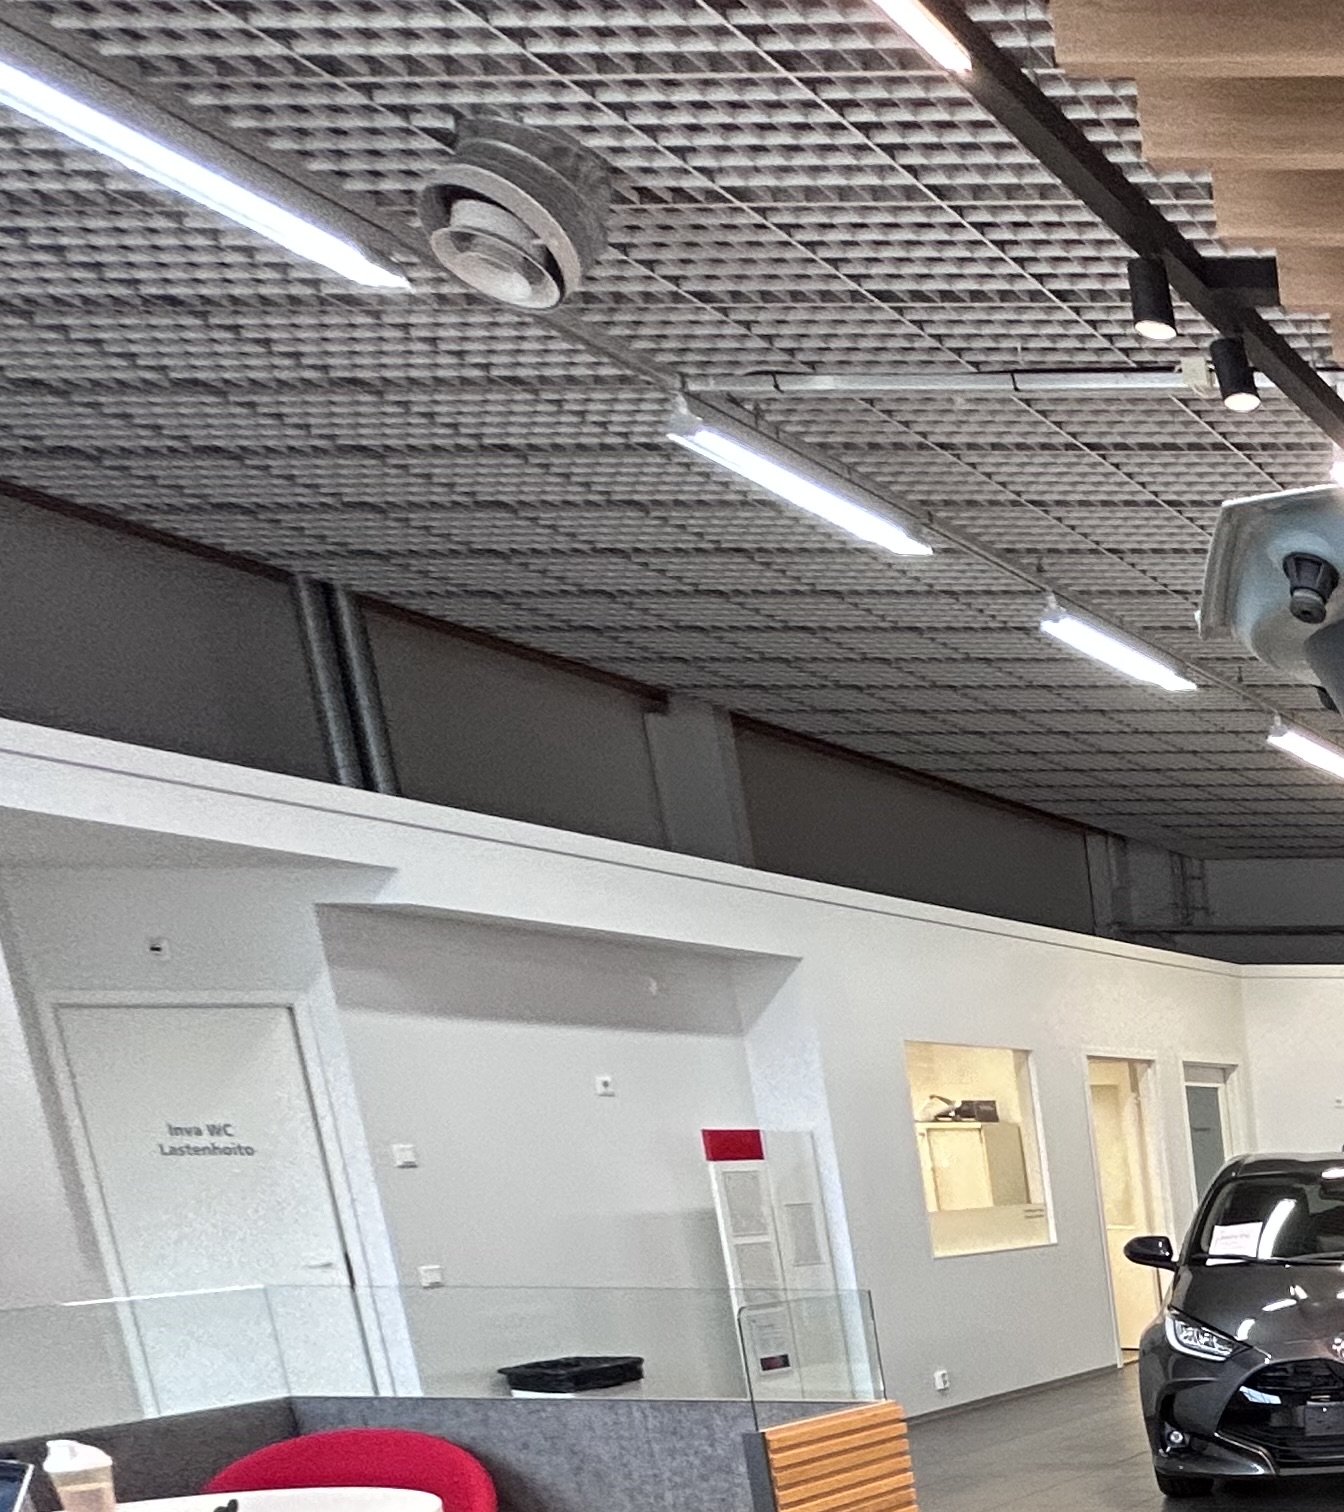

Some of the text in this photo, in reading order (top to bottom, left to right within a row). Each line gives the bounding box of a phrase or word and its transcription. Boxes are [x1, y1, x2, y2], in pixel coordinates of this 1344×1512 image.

[166, 1123, 234, 1137] Inva WC
[158, 1142, 256, 1157] Lastenhoito
